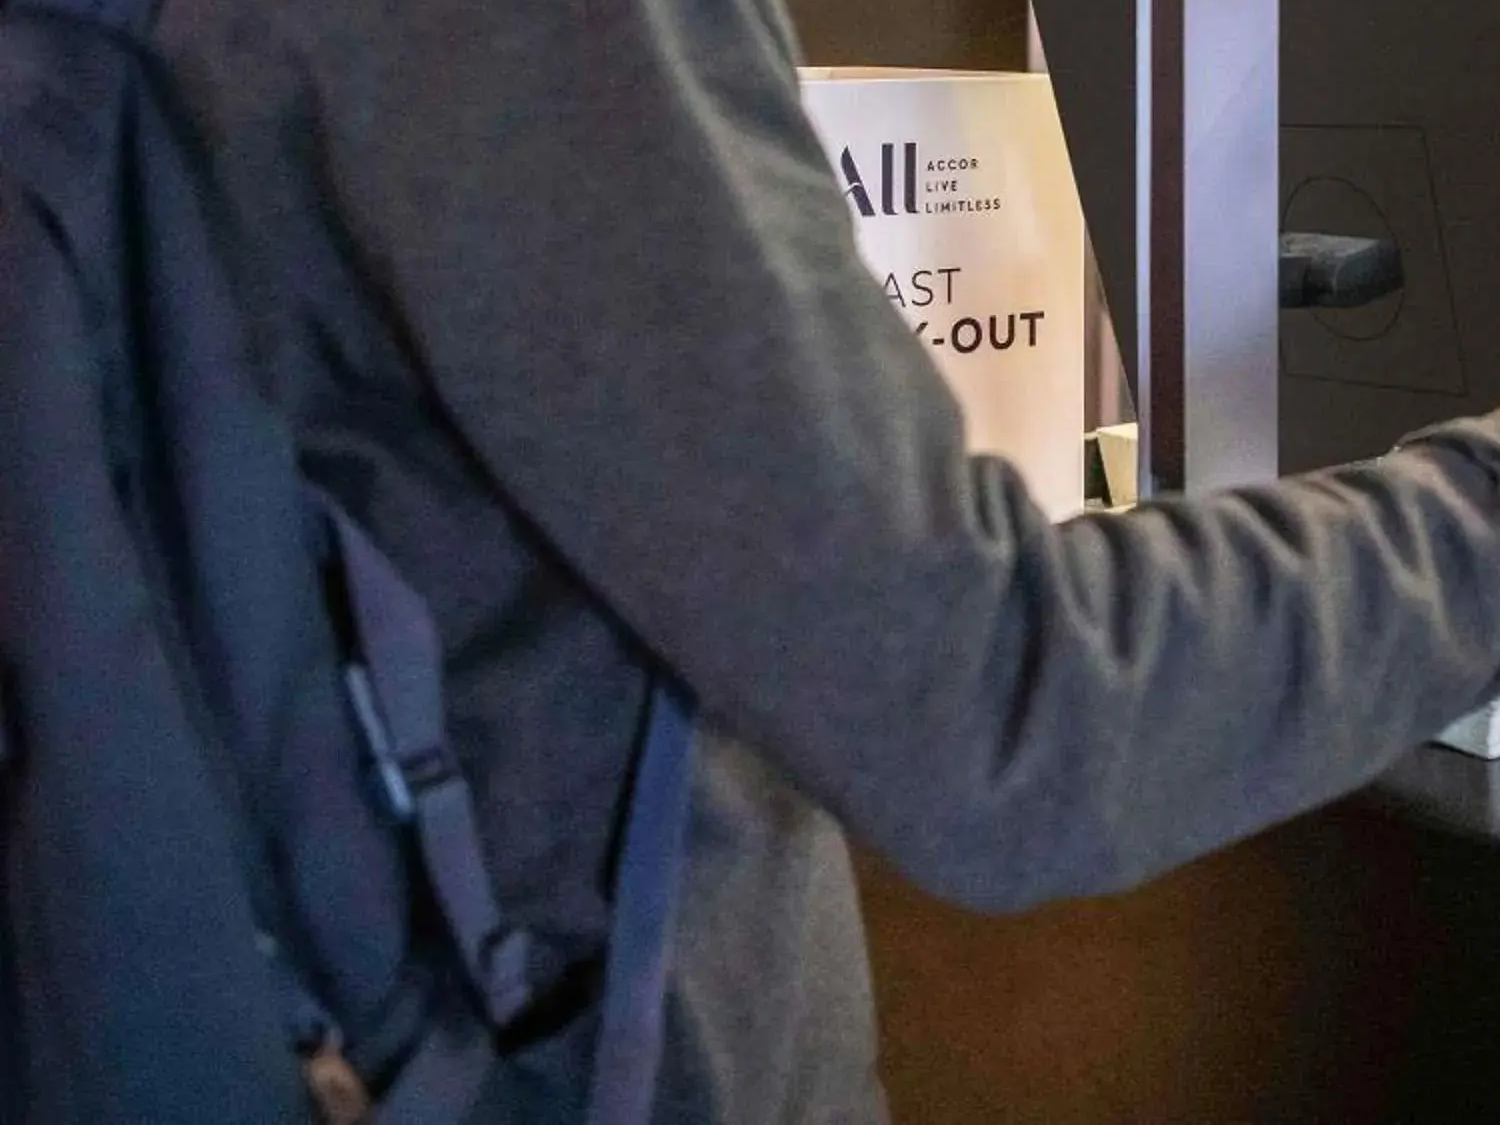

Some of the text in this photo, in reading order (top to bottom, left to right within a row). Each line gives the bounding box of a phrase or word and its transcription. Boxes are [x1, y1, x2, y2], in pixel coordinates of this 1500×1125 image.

[926, 158, 979, 172] ACCOR
[926, 180, 958, 193] LIVE
[925, 198, 1001, 214] LIMITLESS
[915, 311, 1045, 354] -OUT
